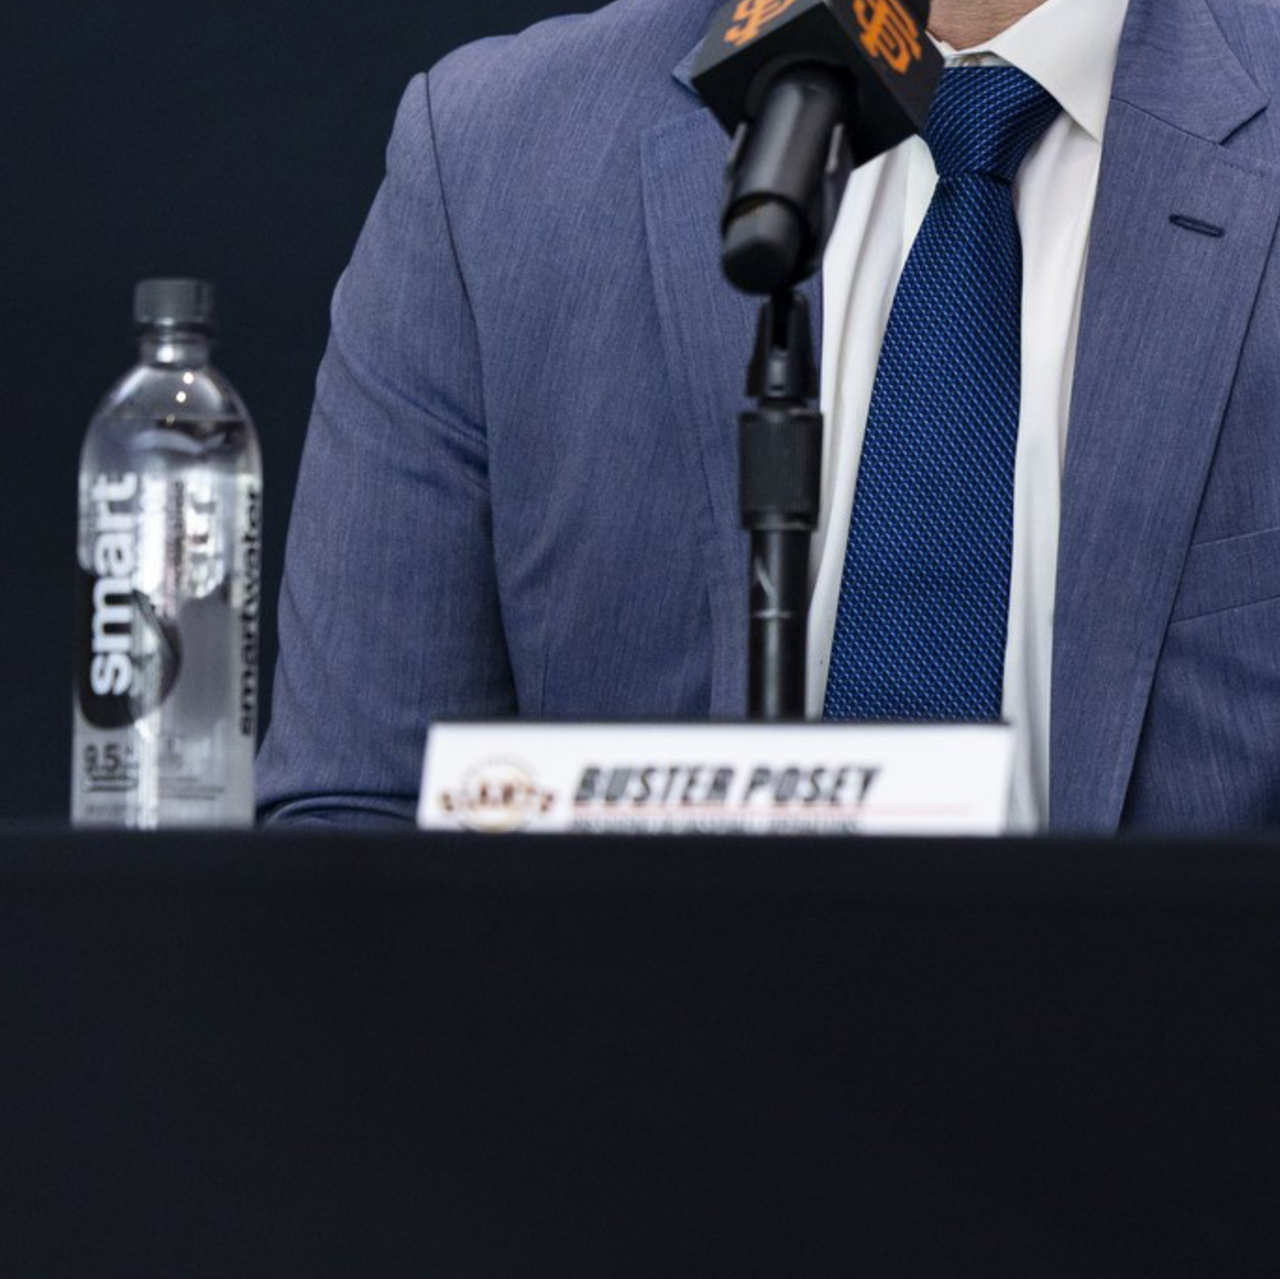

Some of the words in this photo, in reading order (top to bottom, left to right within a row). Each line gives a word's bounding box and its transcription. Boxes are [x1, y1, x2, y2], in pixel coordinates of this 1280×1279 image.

[89, 472, 138, 696] smart
[573, 765, 734, 805] BUSTER
[744, 765, 882, 805] POSEY
